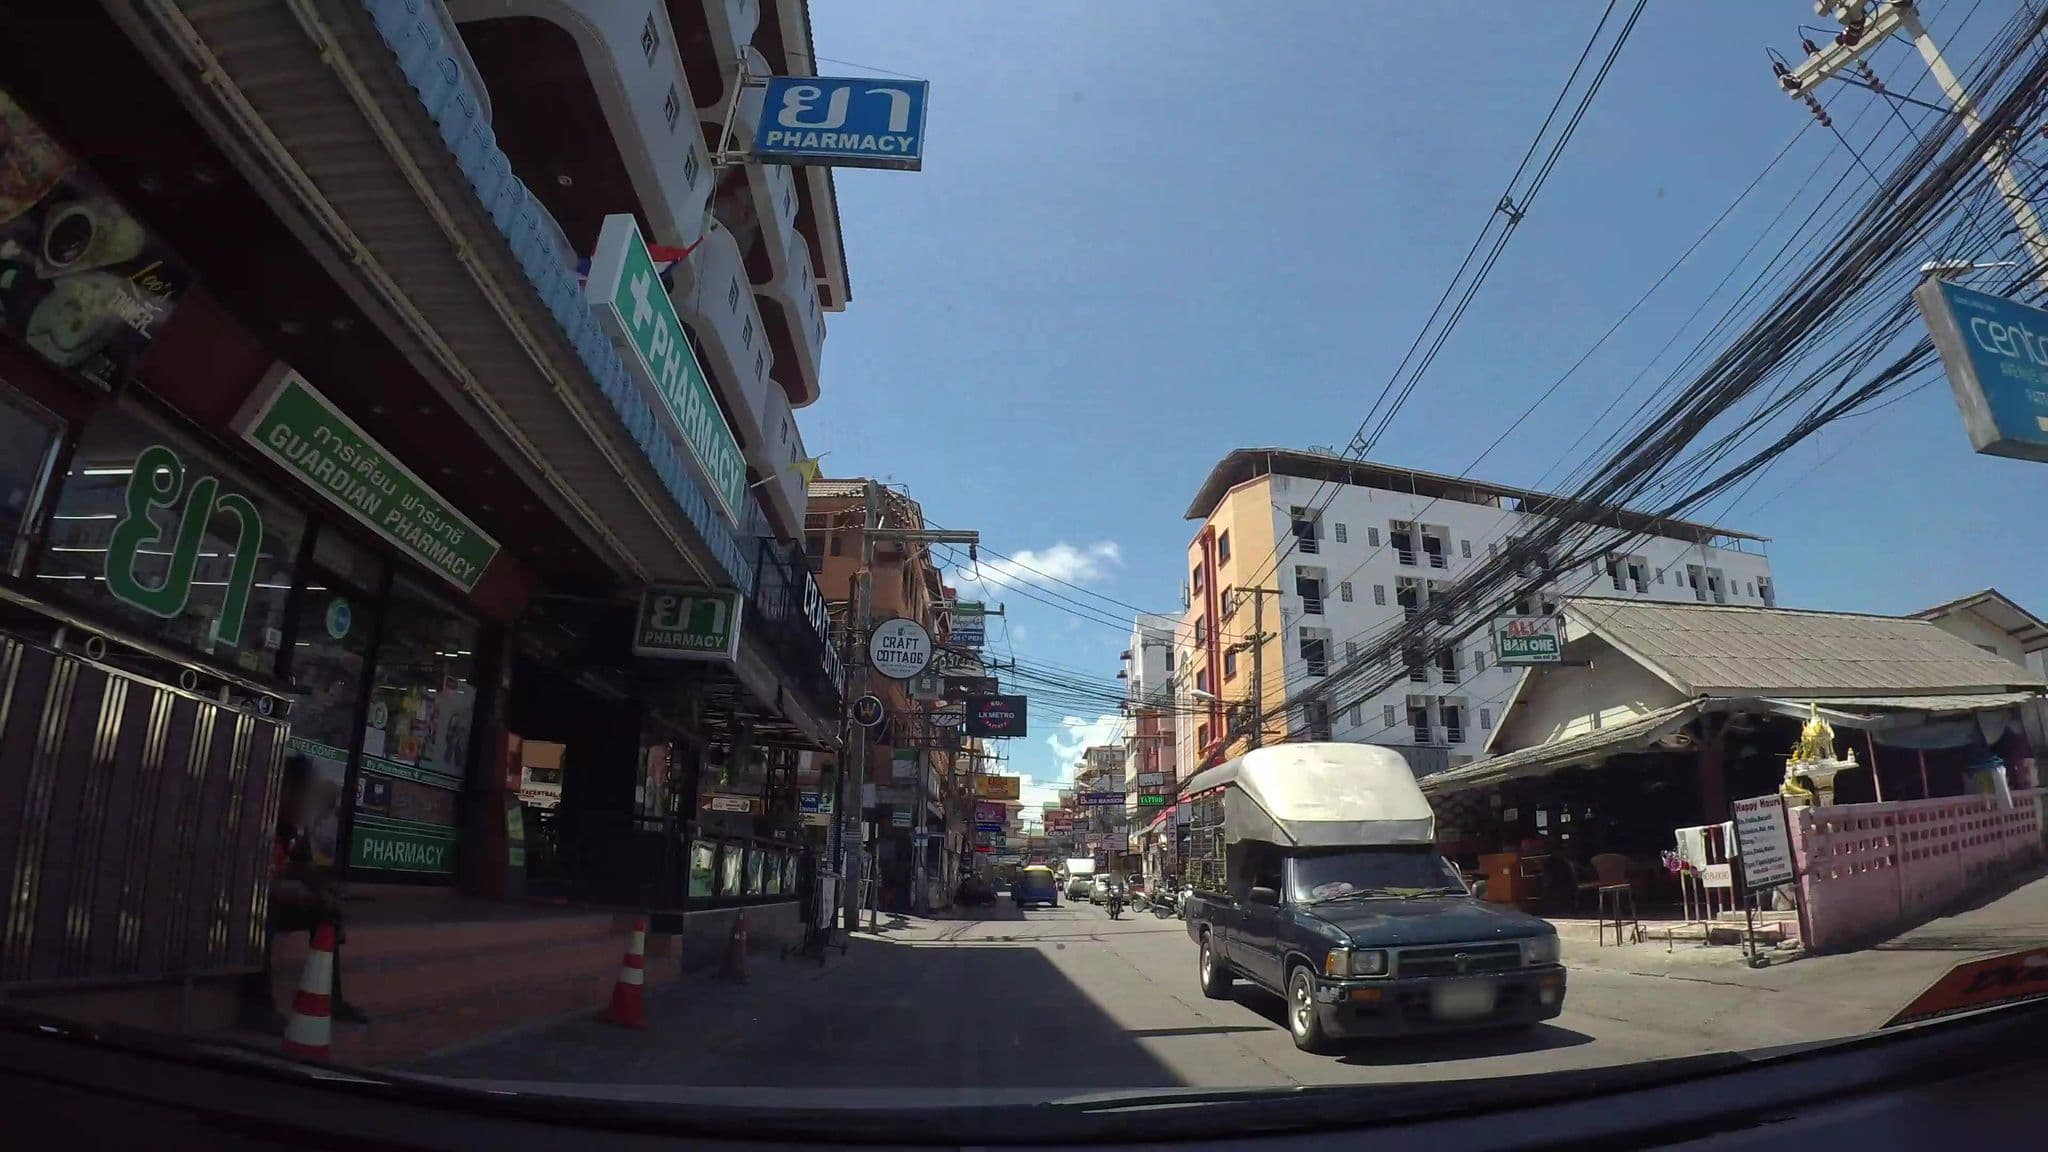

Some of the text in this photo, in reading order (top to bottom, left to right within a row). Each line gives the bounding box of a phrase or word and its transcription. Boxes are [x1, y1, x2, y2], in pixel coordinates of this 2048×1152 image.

[777, 85, 911, 132] ยา
[766, 130, 914, 152] PHARMACY
[649, 311, 740, 505] PHARMACY
[269, 423, 475, 579] GUARDIAN PHARMACY
[104, 445, 263, 648] ยา
[651, 595, 727, 634] ยา
[803, 571, 831, 643] CRAFT
[1508, 620, 1538, 636] ALL
[644, 631, 724, 648] PHARMACY
[882, 636, 919, 650] CRAFT
[1529, 639, 1554, 651] ONE
[876, 650, 924, 664] COTTAGE
[989, 711, 1015, 719] METRO
[292, 739, 337, 760] WELCOME
[1140, 796, 1163, 804] TATTOO
[1735, 802, 1757, 812] Happy
[362, 837, 445, 865] PHARMACY
